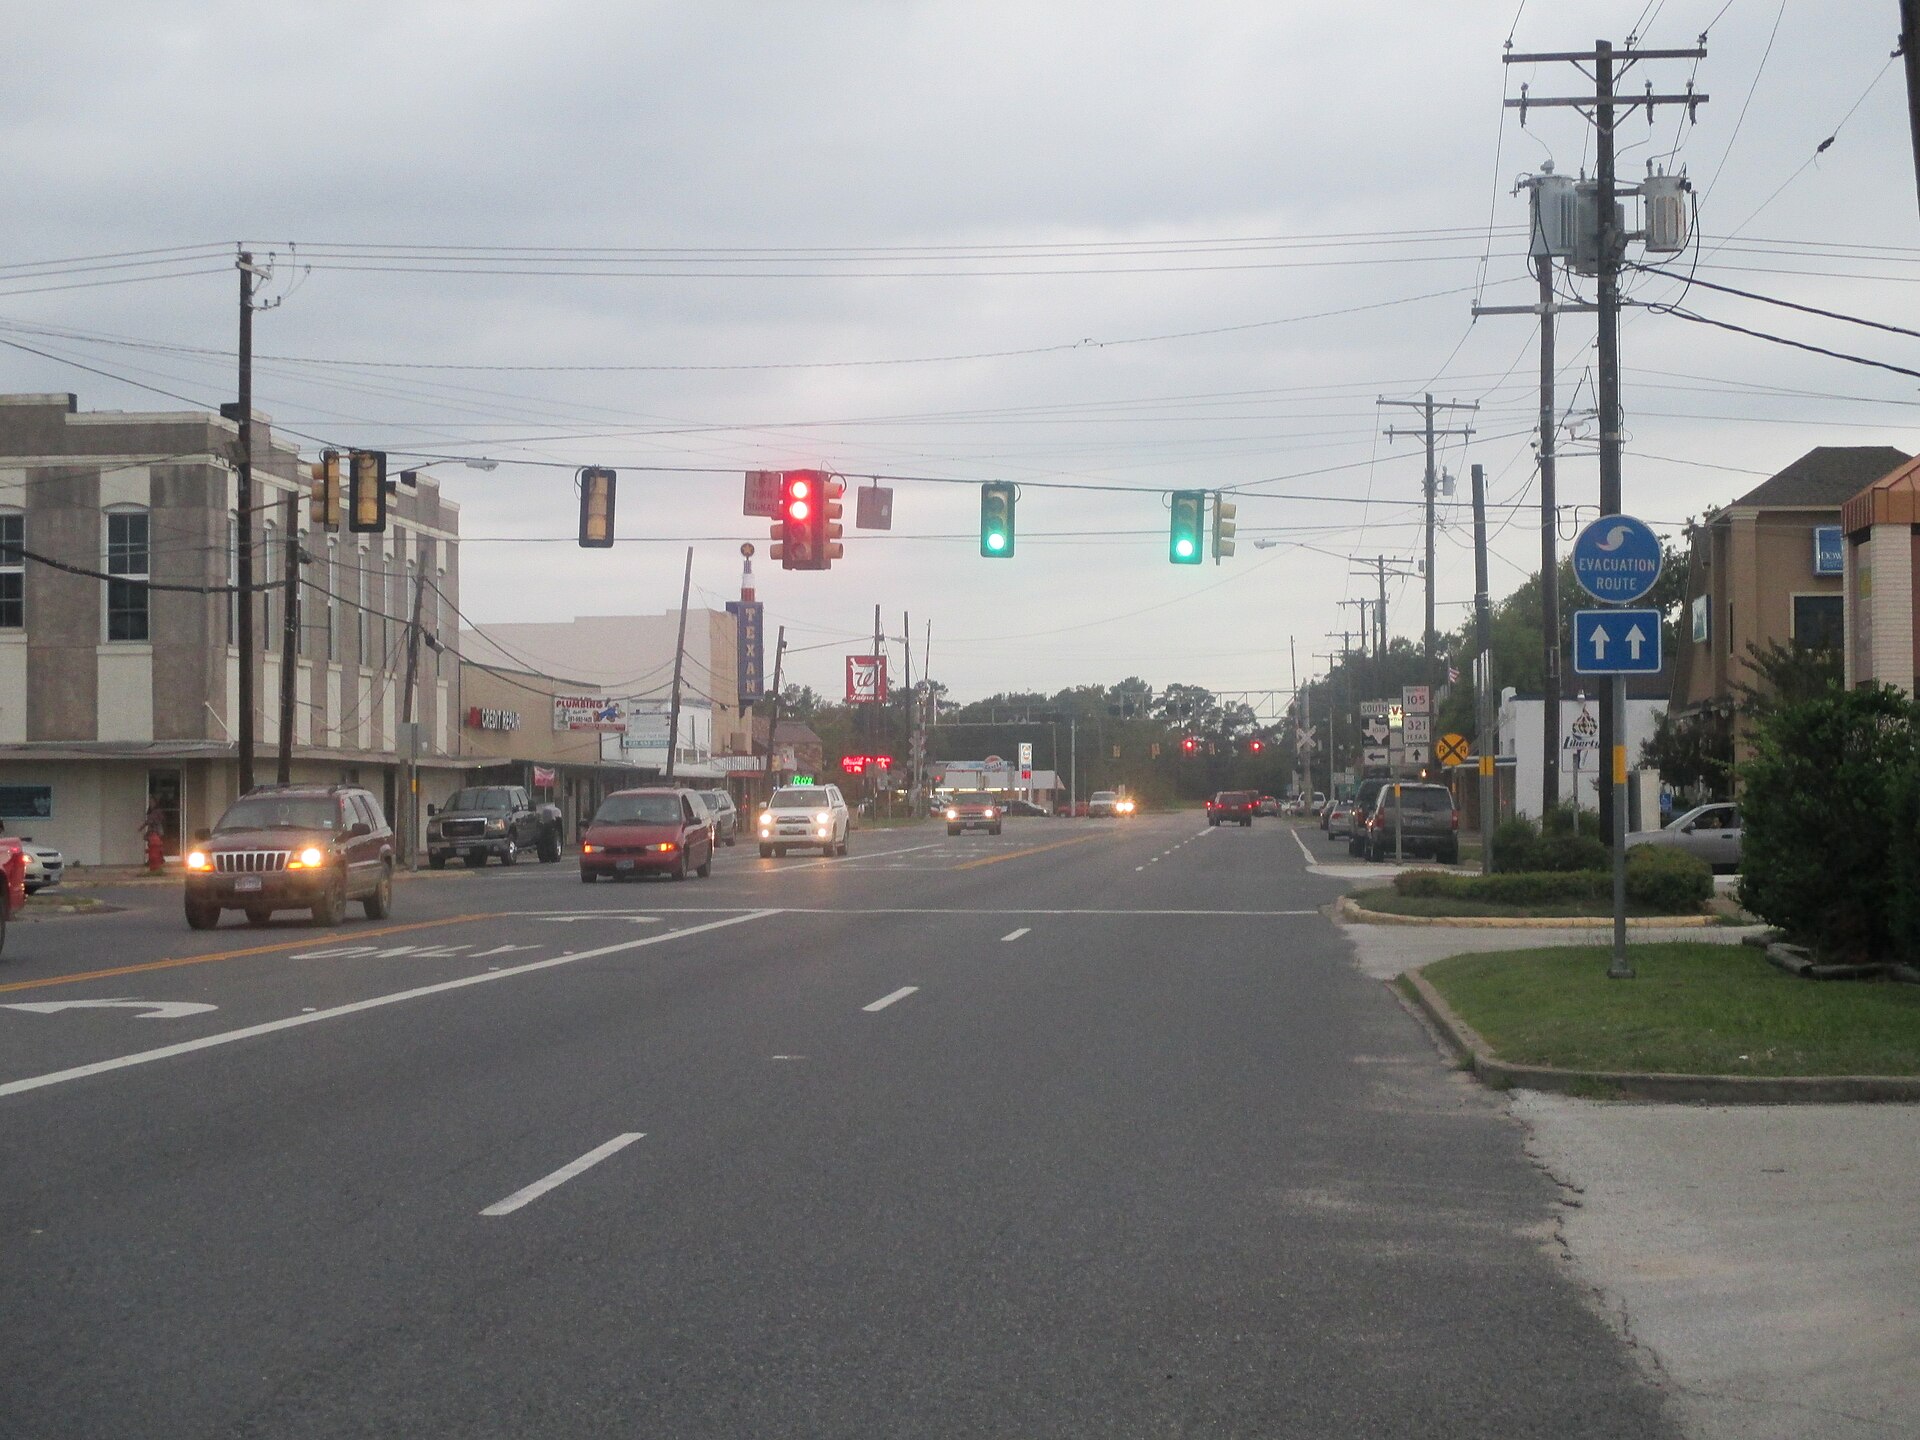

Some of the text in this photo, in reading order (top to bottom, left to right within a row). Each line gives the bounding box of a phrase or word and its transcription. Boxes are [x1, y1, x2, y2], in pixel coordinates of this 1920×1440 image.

[752, 490, 773, 499] TURN
[748, 502, 777, 512] SIGNAL
[1579, 558, 1655, 572] EVACUATION
[1596, 577, 1637, 590] ROUTE
[745, 607, 756, 693] TEXAN
[556, 700, 603, 709] PLUMBING
[1407, 695, 1426, 705] 105
[1362, 705, 1388, 713] SOUTH
[481, 708, 521, 731] CREDIT REPAIR
[1407, 720, 1426, 730] 321
[1439, 745, 1467, 753] R R
